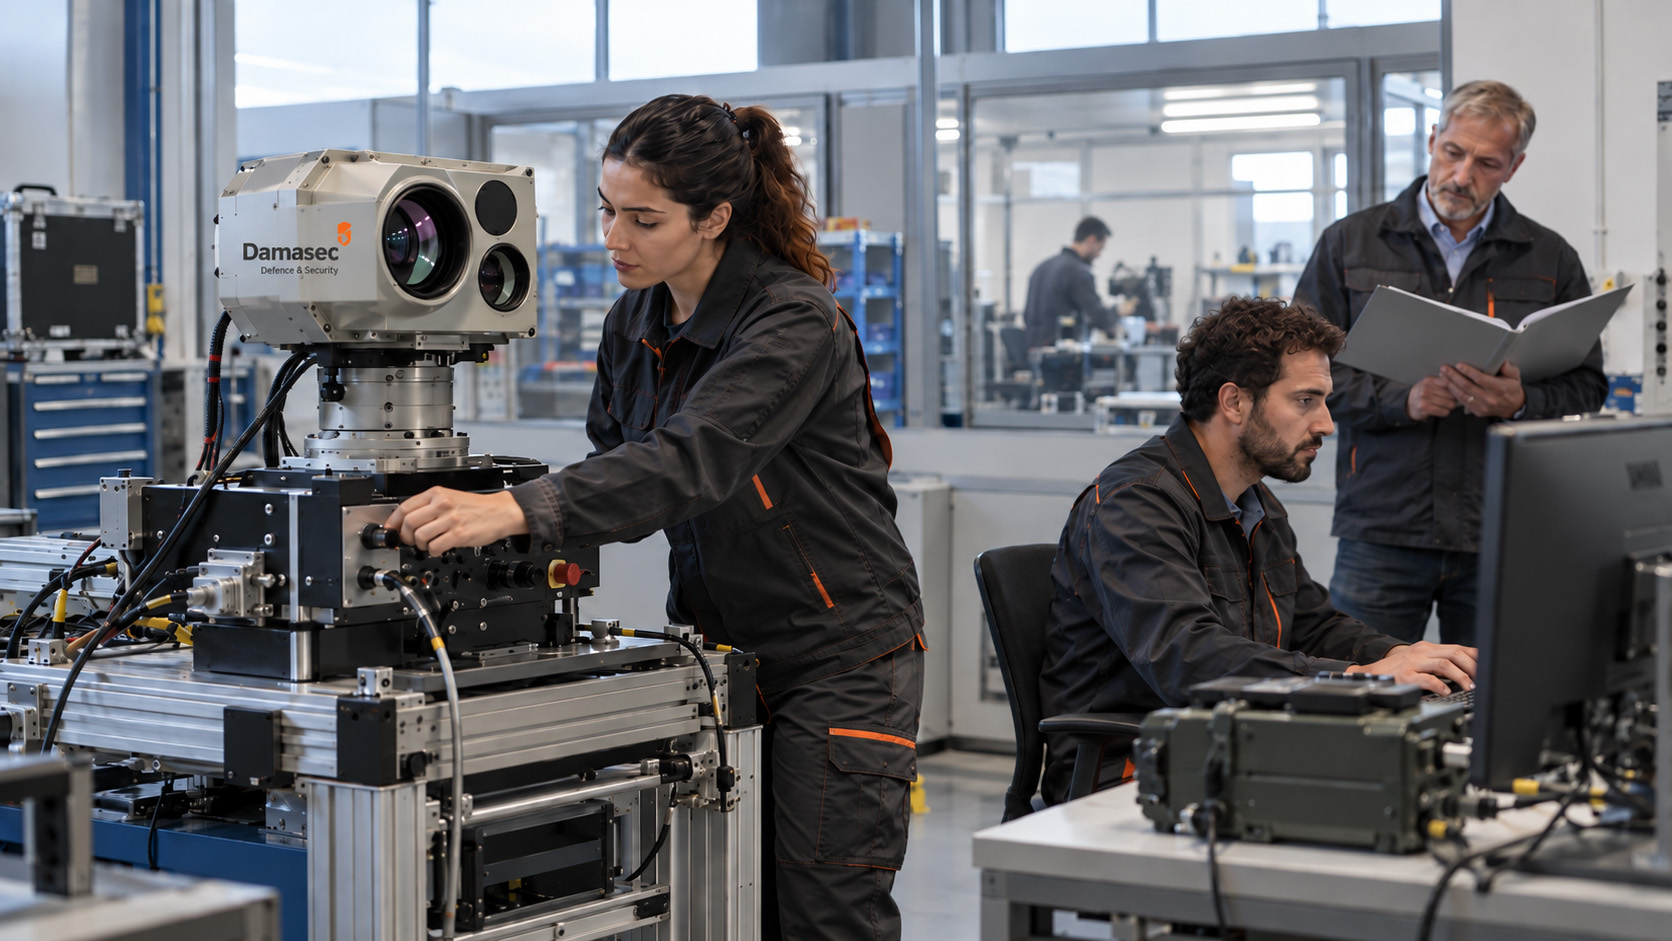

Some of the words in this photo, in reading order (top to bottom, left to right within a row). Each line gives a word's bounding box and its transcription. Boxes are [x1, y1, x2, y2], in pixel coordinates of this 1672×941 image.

[242, 242, 339, 261] Damasec
[260, 266, 295, 275] Defence
[296, 266, 303, 275] &
[304, 266, 339, 276] Security
